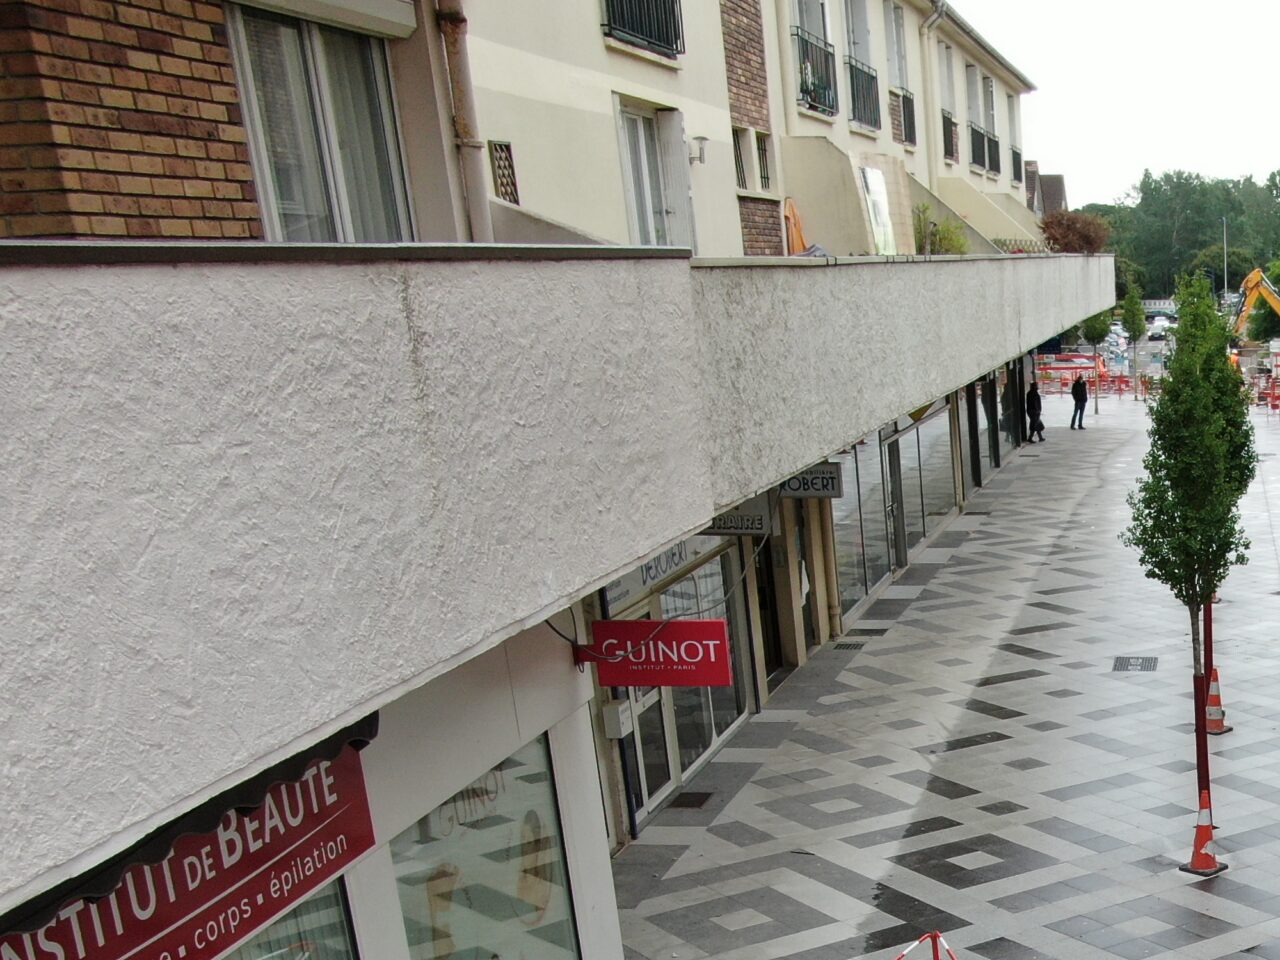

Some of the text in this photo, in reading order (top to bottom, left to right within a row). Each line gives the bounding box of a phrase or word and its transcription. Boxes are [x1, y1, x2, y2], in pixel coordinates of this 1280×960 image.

[602, 639, 720, 662] GUINOT
[183, 845, 216, 891] DE
[217, 760, 338, 870] BEAUTE
[194, 894, 252, 950] corps
[270, 832, 348, 898] épilation
